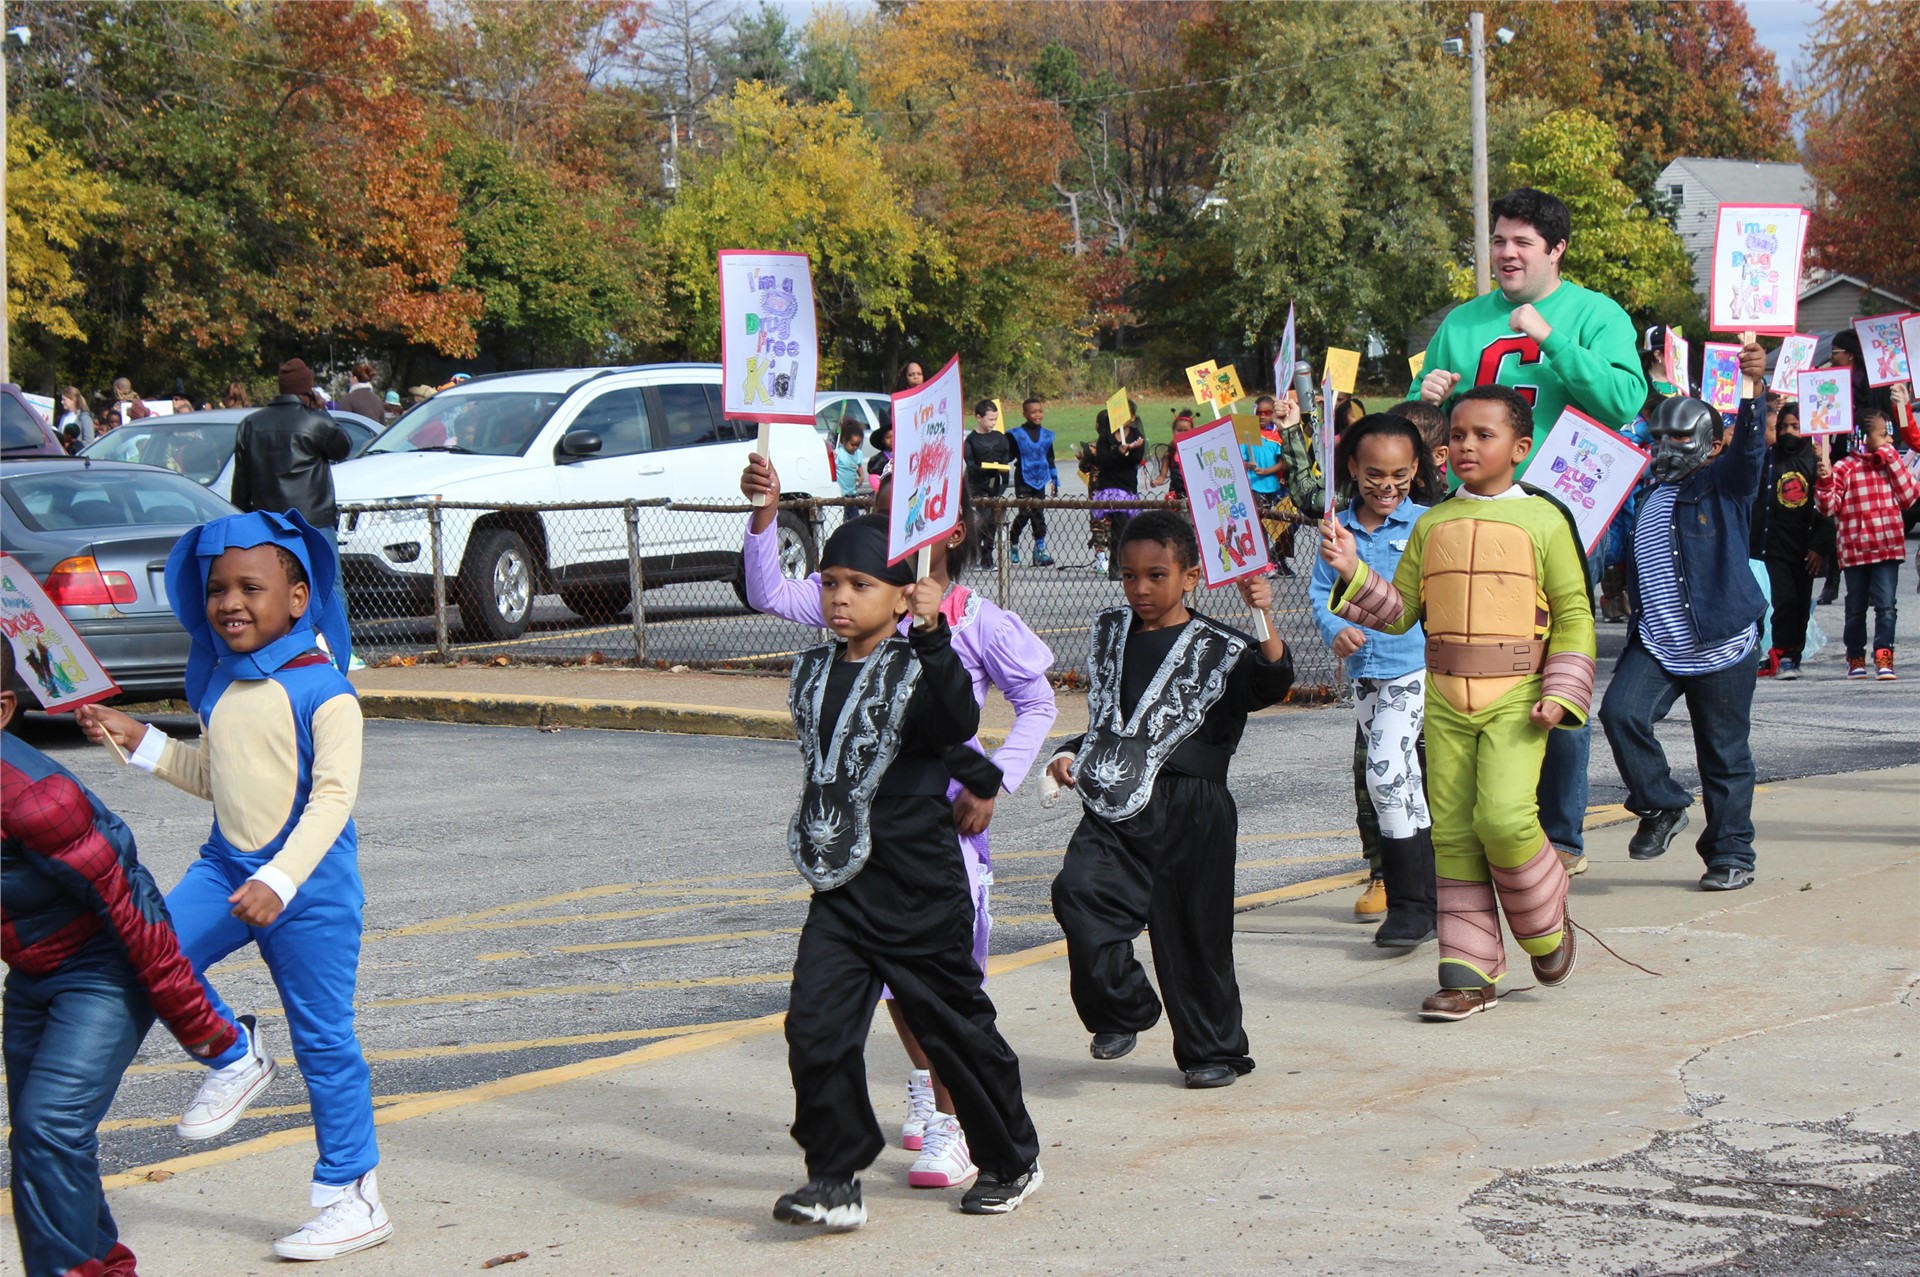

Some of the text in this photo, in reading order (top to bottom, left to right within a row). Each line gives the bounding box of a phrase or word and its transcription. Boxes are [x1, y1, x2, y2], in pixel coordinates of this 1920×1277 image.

[1732, 251, 1771, 270] Drug
[747, 268, 794, 294] I'm a
[1729, 282, 1779, 320] Kid
[745, 313, 791, 340] Drug
[757, 331, 800, 357] Free
[742, 355, 799, 406] Kid
[914, 398, 947, 431] I'm a
[926, 421, 946, 436] 100%
[1195, 446, 1229, 471] I'm a
[1571, 431, 1616, 468] I'm a
[1213, 466, 1234, 480] 100%
[1551, 455, 1598, 494] Drug
[1581, 454, 1605, 480] 100%
[1203, 482, 1239, 510] Drug
[1554, 473, 1596, 510] Free
[1216, 501, 1248, 523] Free
[1214, 519, 1257, 573] Kid
[0, 609, 45, 639] Drug
